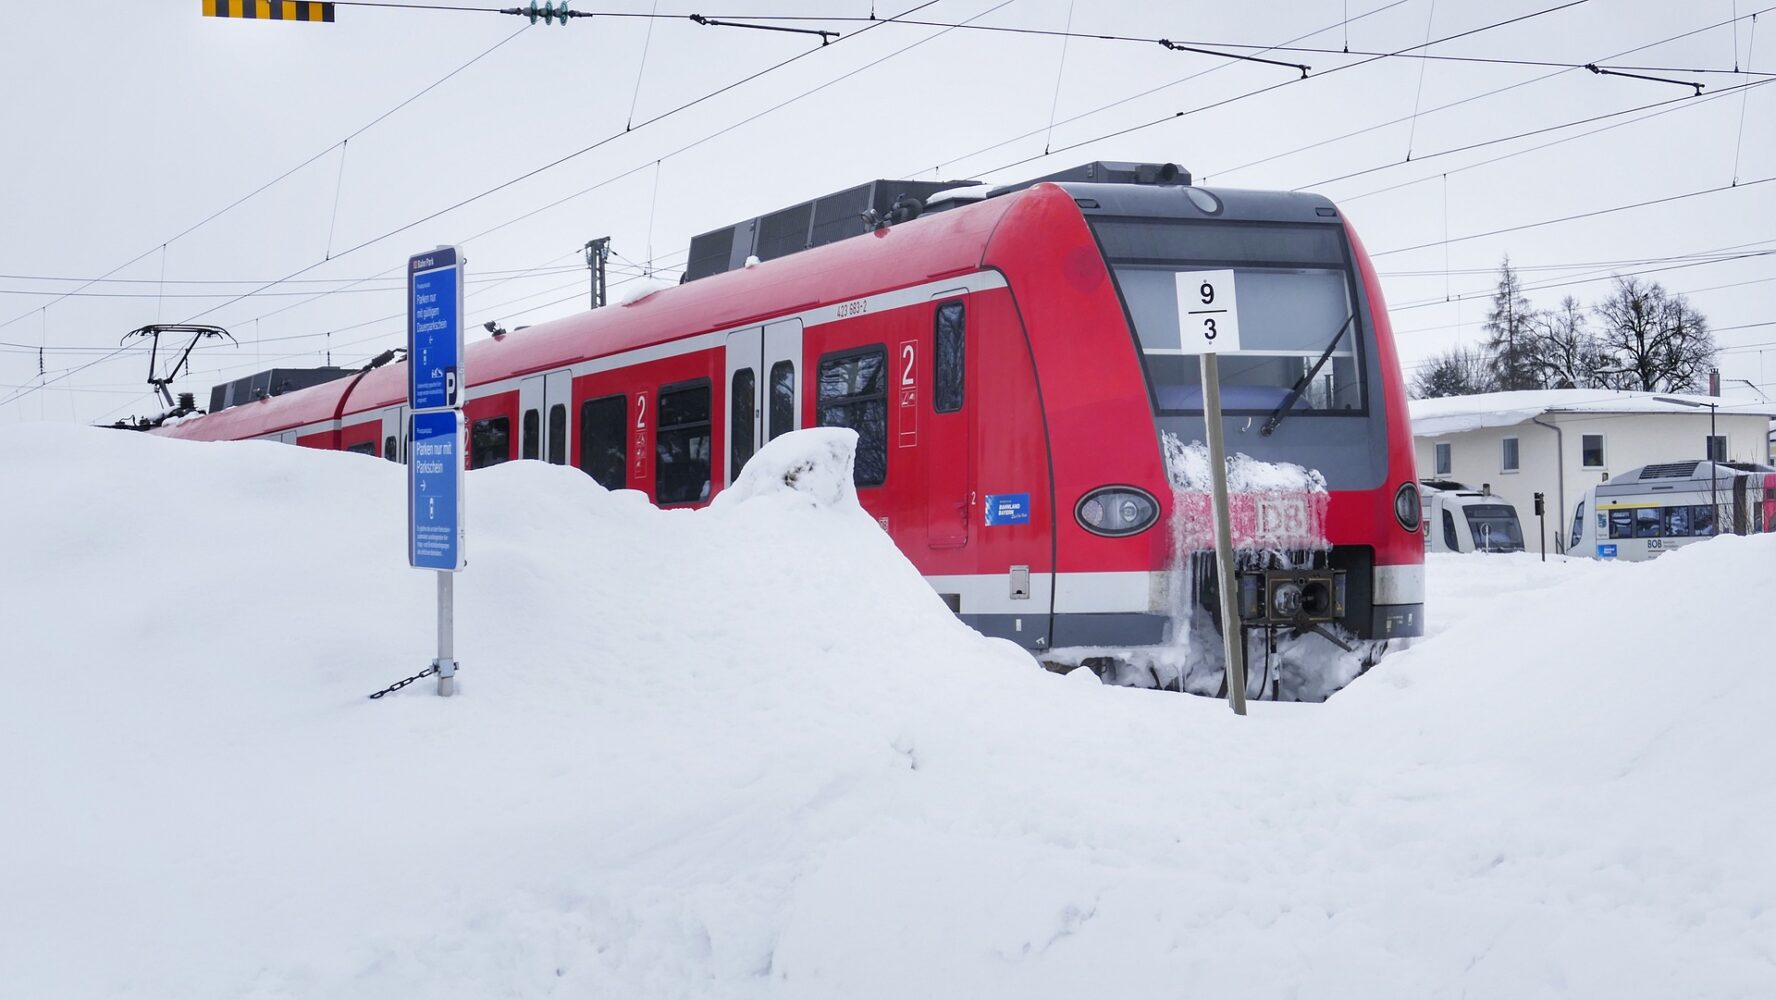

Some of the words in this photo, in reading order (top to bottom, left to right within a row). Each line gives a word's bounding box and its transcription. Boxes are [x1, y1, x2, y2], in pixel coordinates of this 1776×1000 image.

[1200, 283, 1215, 305] 9
[837, 304, 848, 317] 423
[1204, 318, 1217, 340] 3
[902, 345, 915, 385] 2
[446, 372, 456, 407] P
[637, 395, 646, 428] 2
[416, 442, 433, 456] Parken
[433, 444, 442, 455] nur
[442, 441, 452, 455] mit
[416, 459, 444, 474] Parkschein
[971, 491, 976, 505] 2
[1262, 504, 1303, 533] DB
[1647, 539, 1663, 549] BOB
